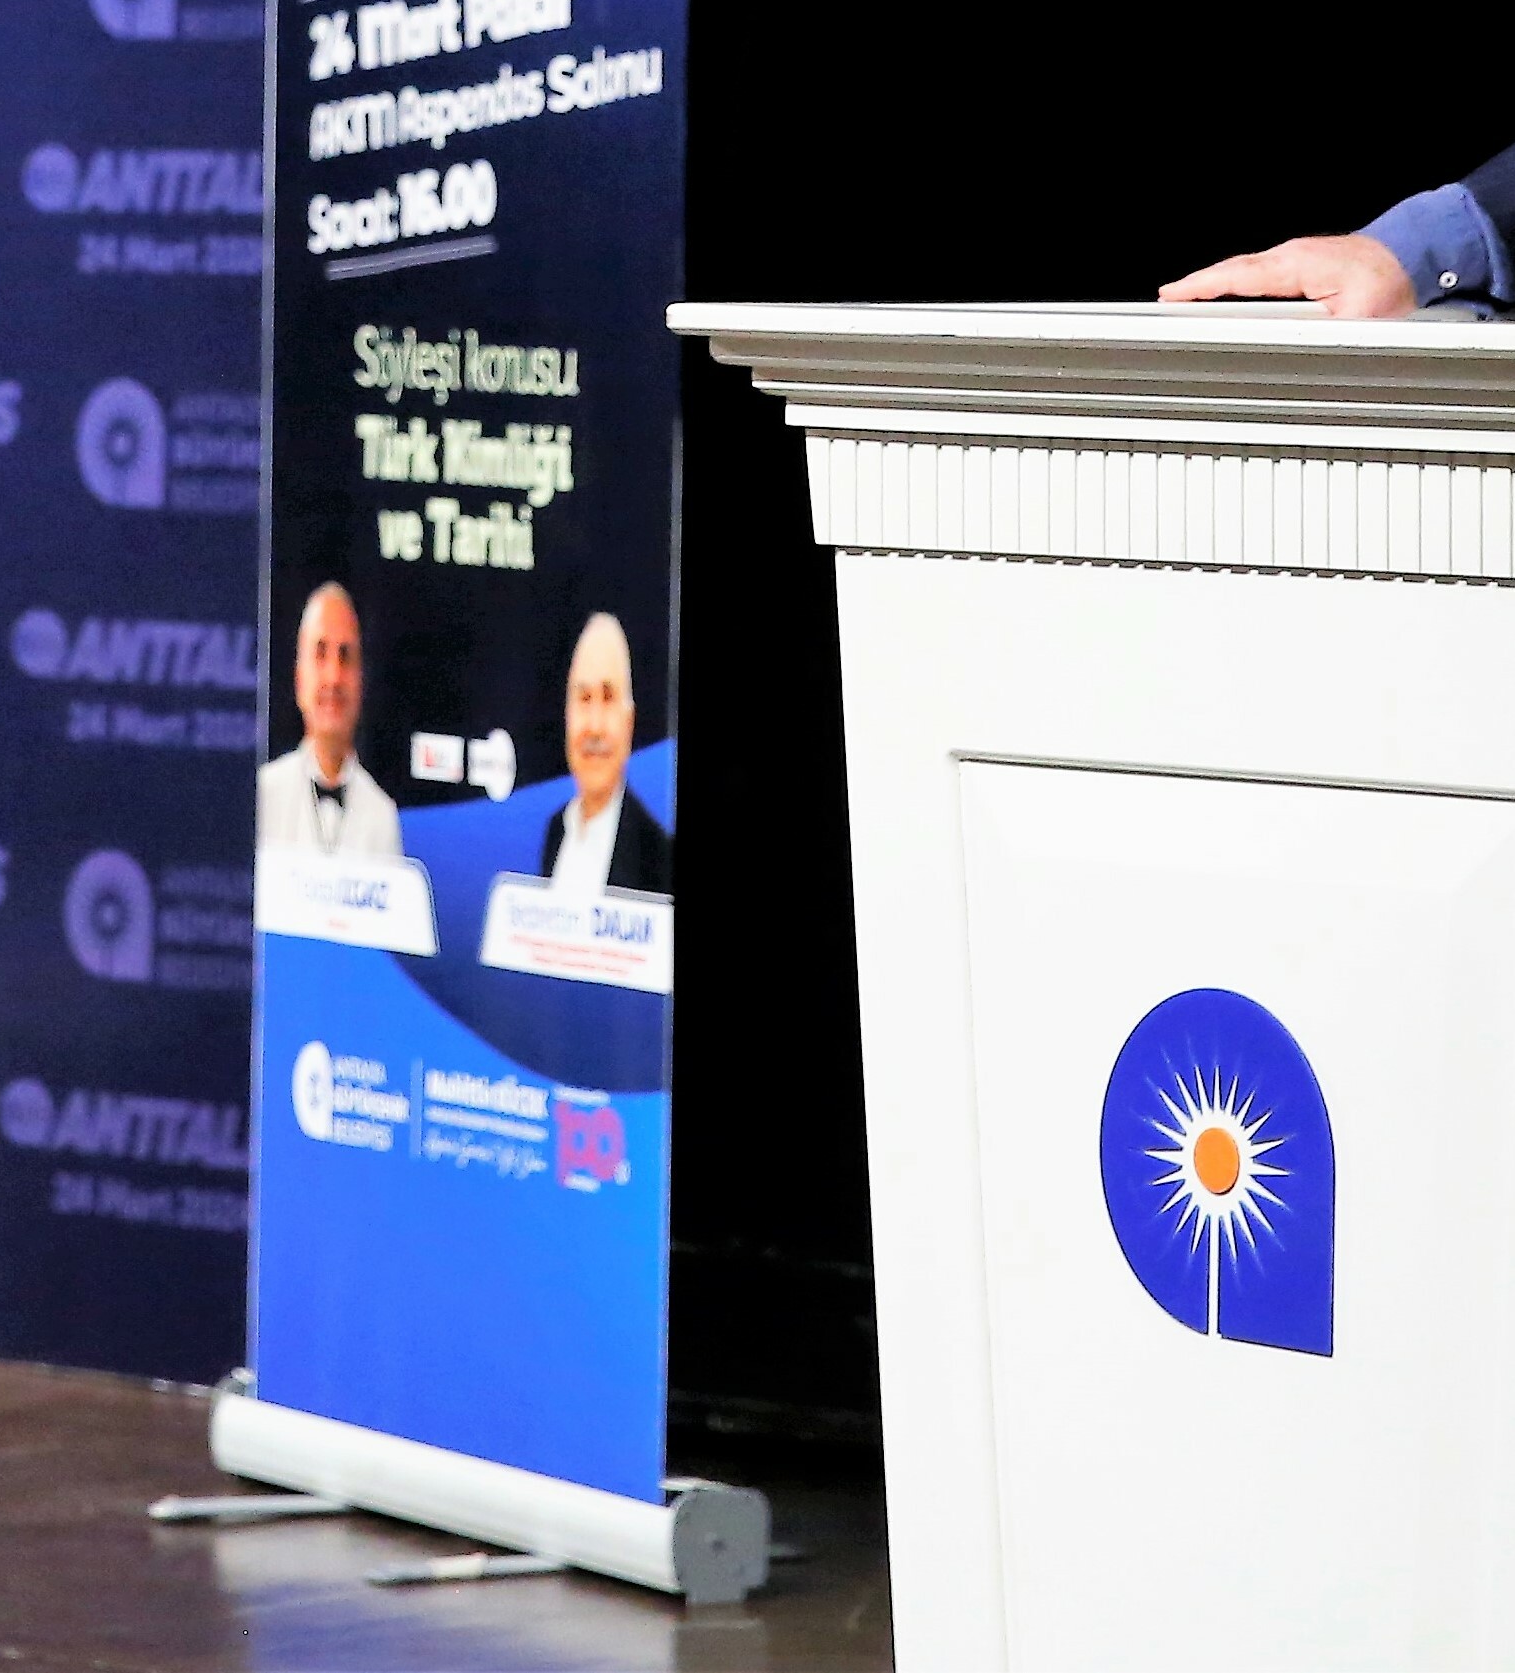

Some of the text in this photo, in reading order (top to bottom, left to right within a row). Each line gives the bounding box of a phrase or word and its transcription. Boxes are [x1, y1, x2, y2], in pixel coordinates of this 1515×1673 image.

[308, 9, 357, 82] 24
[545, 45, 664, 114] Salonu
[75, 149, 262, 215] ANTTAL
[308, 158, 498, 255] Saat 16.00
[353, 324, 581, 406] Söyleşi konusu
[354, 413, 440, 484] Türk
[441, 418, 576, 508] Kimliği
[377, 496, 536, 571] ve Tarihi
[66, 616, 258, 690] ANTTAL
[50, 1089, 249, 1170] ANTTAL
